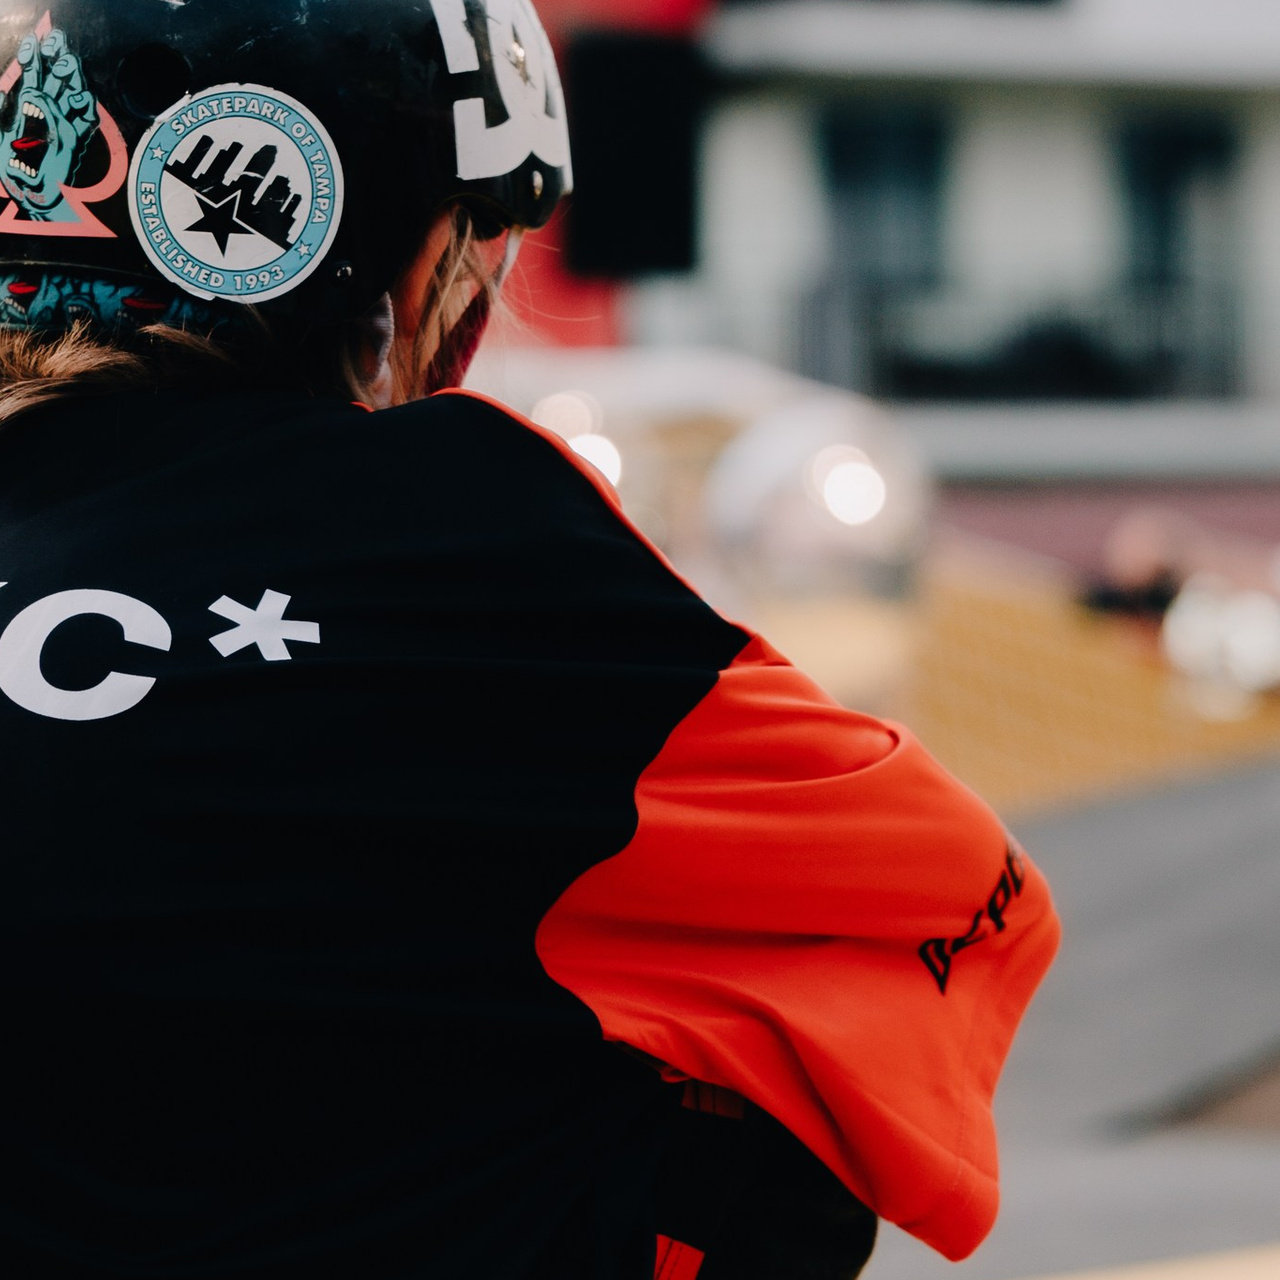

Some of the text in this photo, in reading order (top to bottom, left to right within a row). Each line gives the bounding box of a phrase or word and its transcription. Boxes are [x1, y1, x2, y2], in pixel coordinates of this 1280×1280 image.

[170, 97, 330, 224] SKATEPARK OF TAMPA
[140, 181, 286, 290] ESTABLISHED 1993
